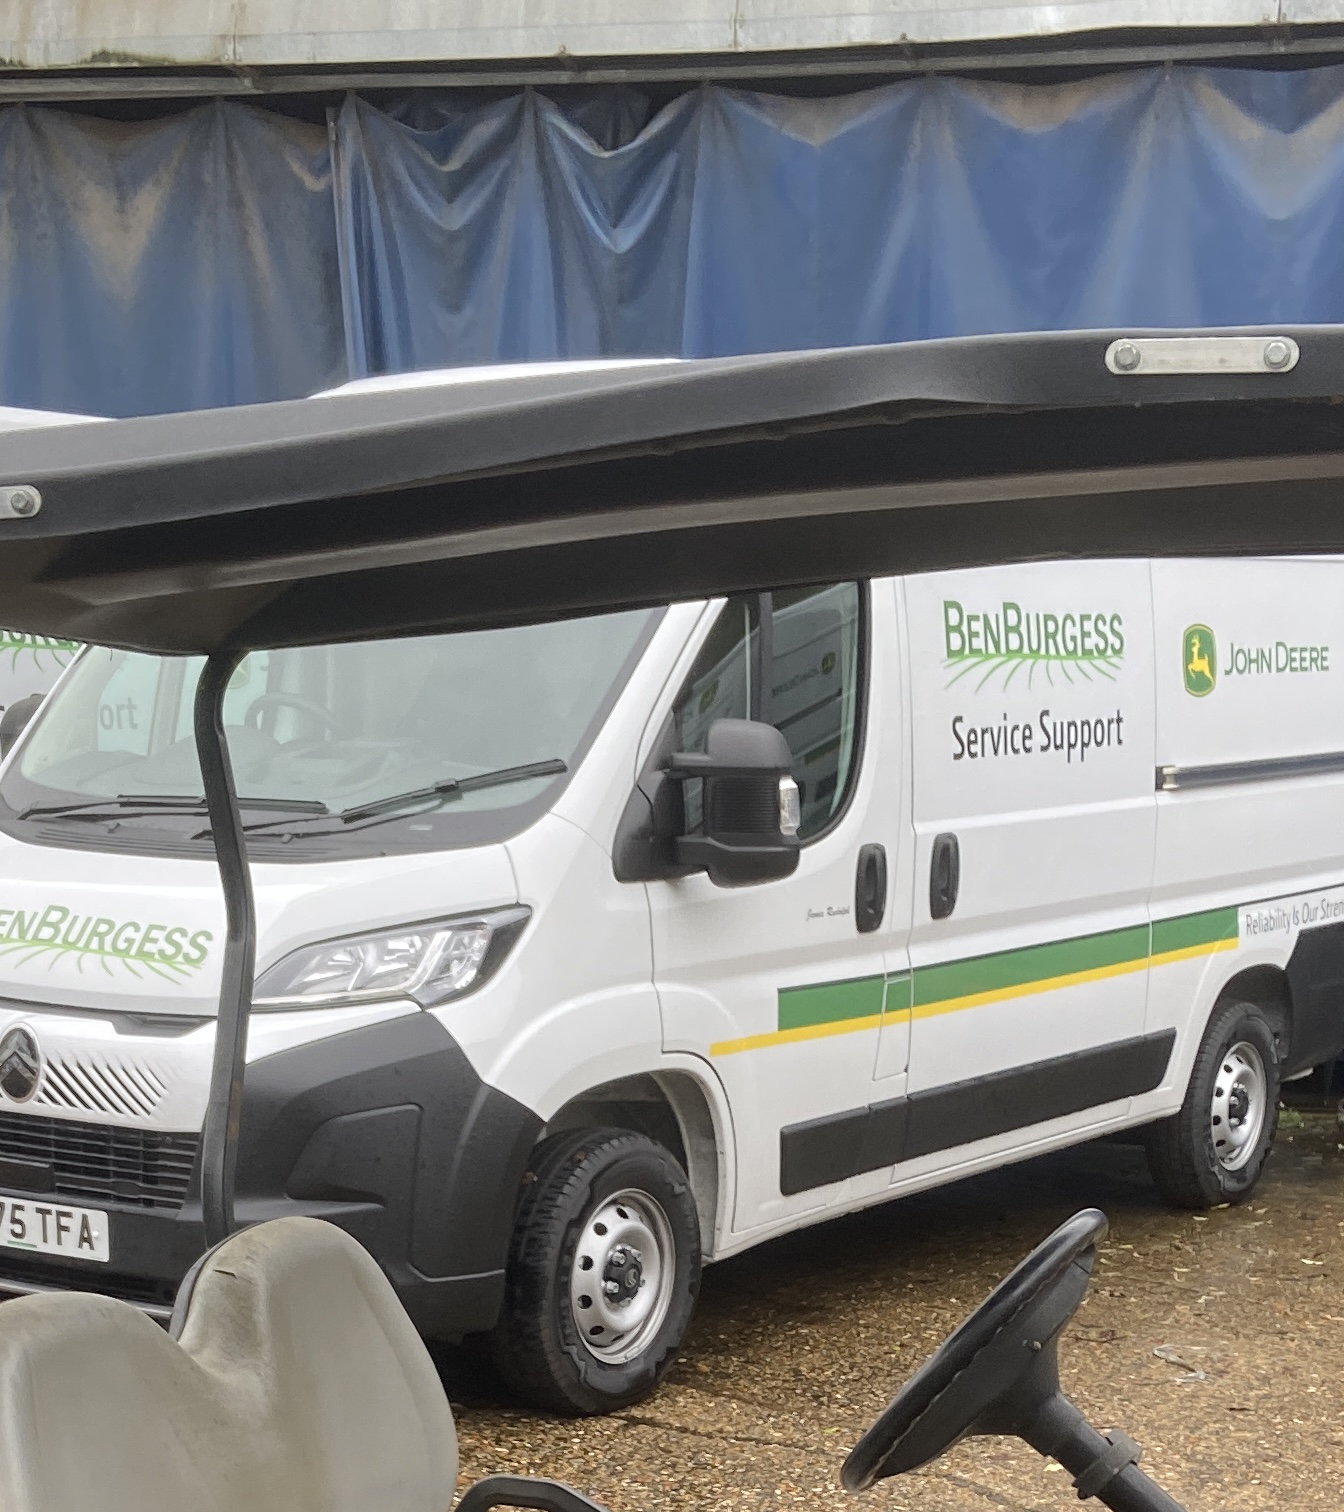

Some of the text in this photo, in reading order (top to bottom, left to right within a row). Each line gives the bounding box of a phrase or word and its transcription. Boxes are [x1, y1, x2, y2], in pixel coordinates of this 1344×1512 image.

[952, 708, 1124, 764] Service Support
[1245, 907, 1292, 937] Reliability
[1301, 902, 1319, 924] Our
[34, 1206, 96, 1251] TFA
